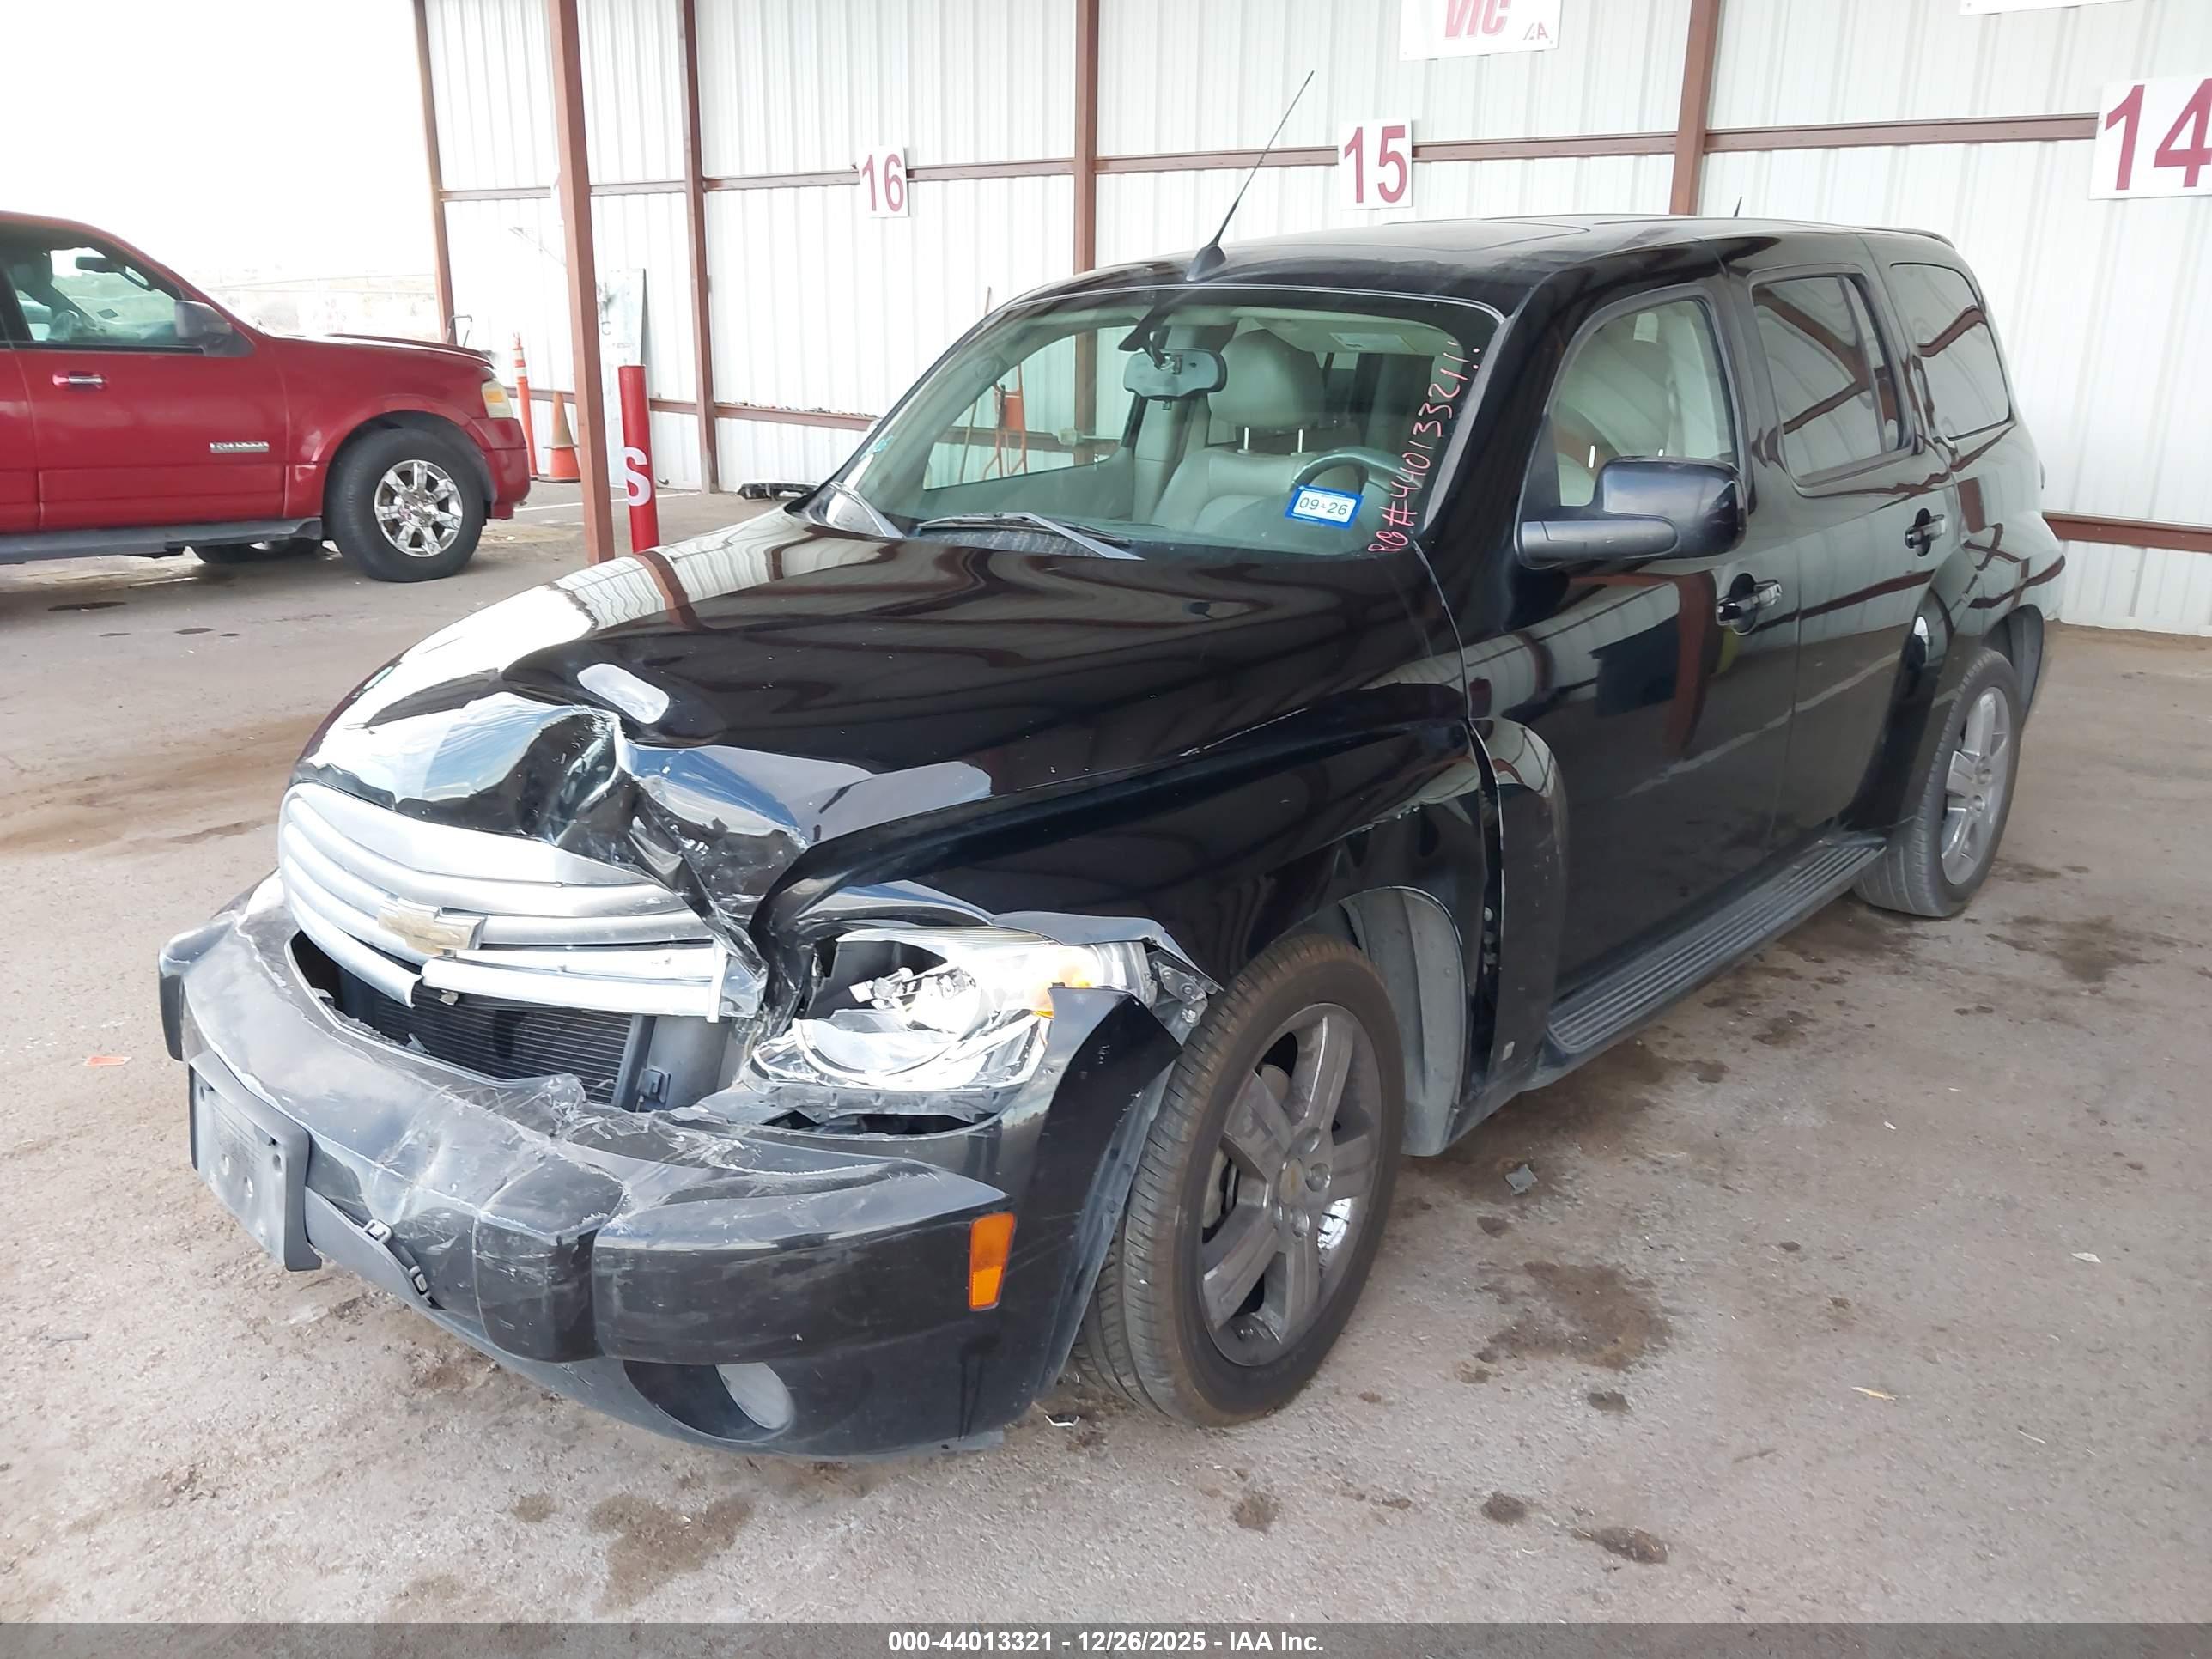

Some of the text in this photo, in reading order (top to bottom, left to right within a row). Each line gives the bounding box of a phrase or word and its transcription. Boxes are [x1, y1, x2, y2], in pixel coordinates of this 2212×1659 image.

[1344, 125, 1407, 204] 15
[2104, 78, 2212, 191] 14
[862, 153, 904, 212] 16
